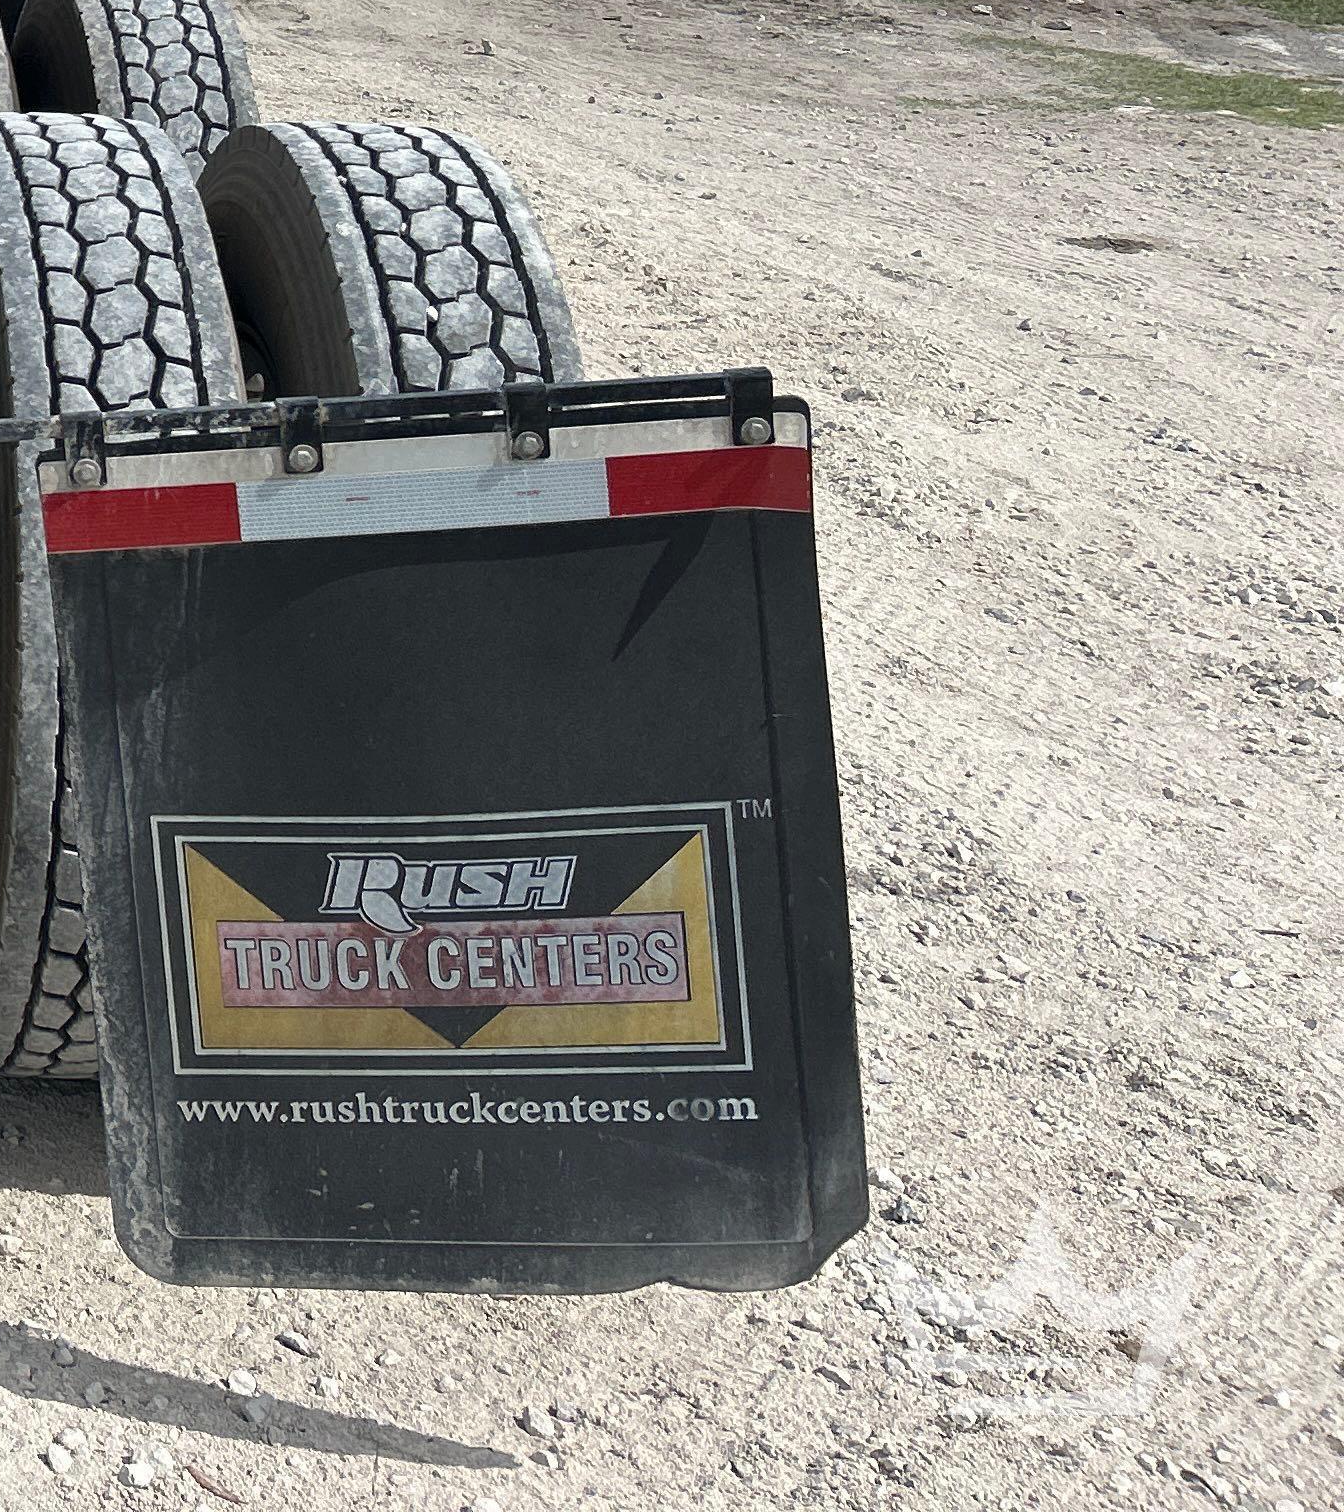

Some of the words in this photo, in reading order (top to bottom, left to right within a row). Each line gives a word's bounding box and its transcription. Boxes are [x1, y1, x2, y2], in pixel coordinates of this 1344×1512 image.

[319, 851, 578, 936] RUSH
[224, 936, 411, 992] TRUCK
[426, 929, 681, 990] CENTERS
[177, 1091, 759, 1125] www.rushtruckcenters.com
